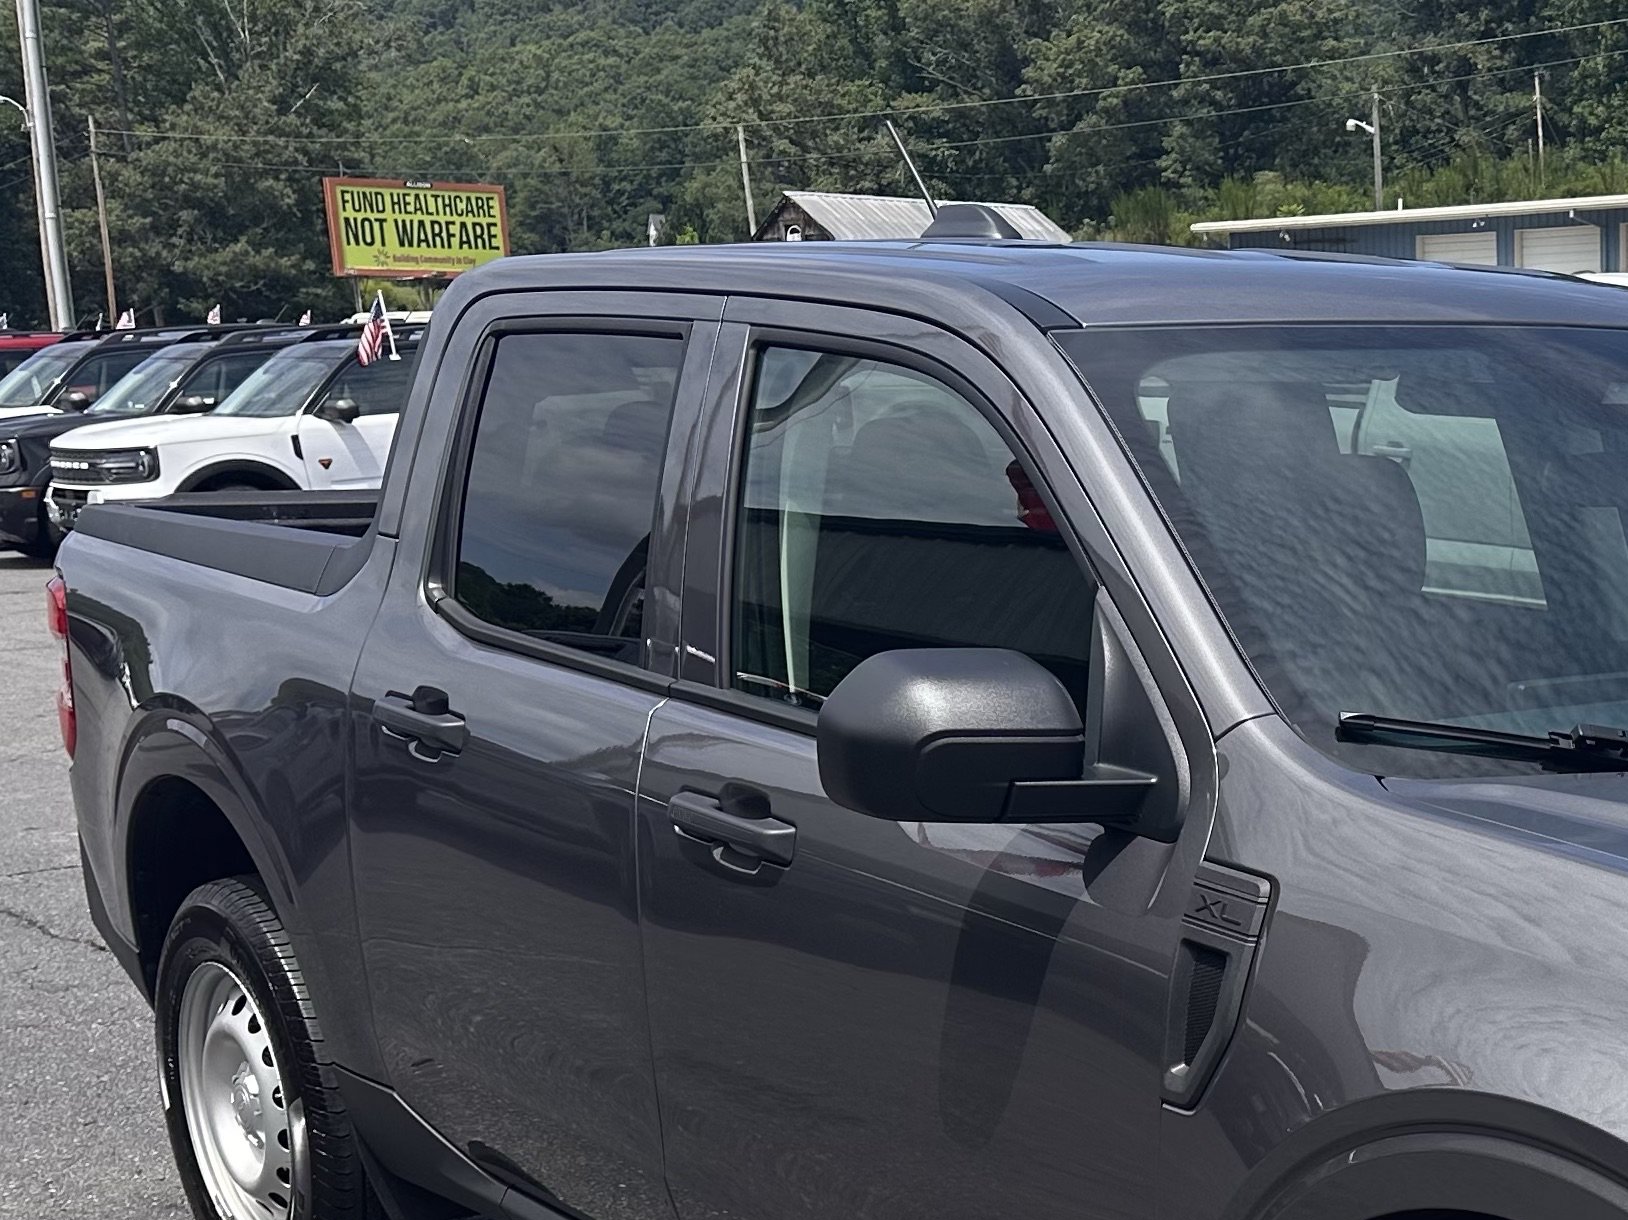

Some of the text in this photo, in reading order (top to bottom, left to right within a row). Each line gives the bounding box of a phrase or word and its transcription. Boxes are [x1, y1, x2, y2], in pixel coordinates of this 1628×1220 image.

[340, 189, 497, 218] FUND HEALTHCARE
[343, 216, 500, 250] NOT WARFARE
[1194, 894, 1242, 926] XL
